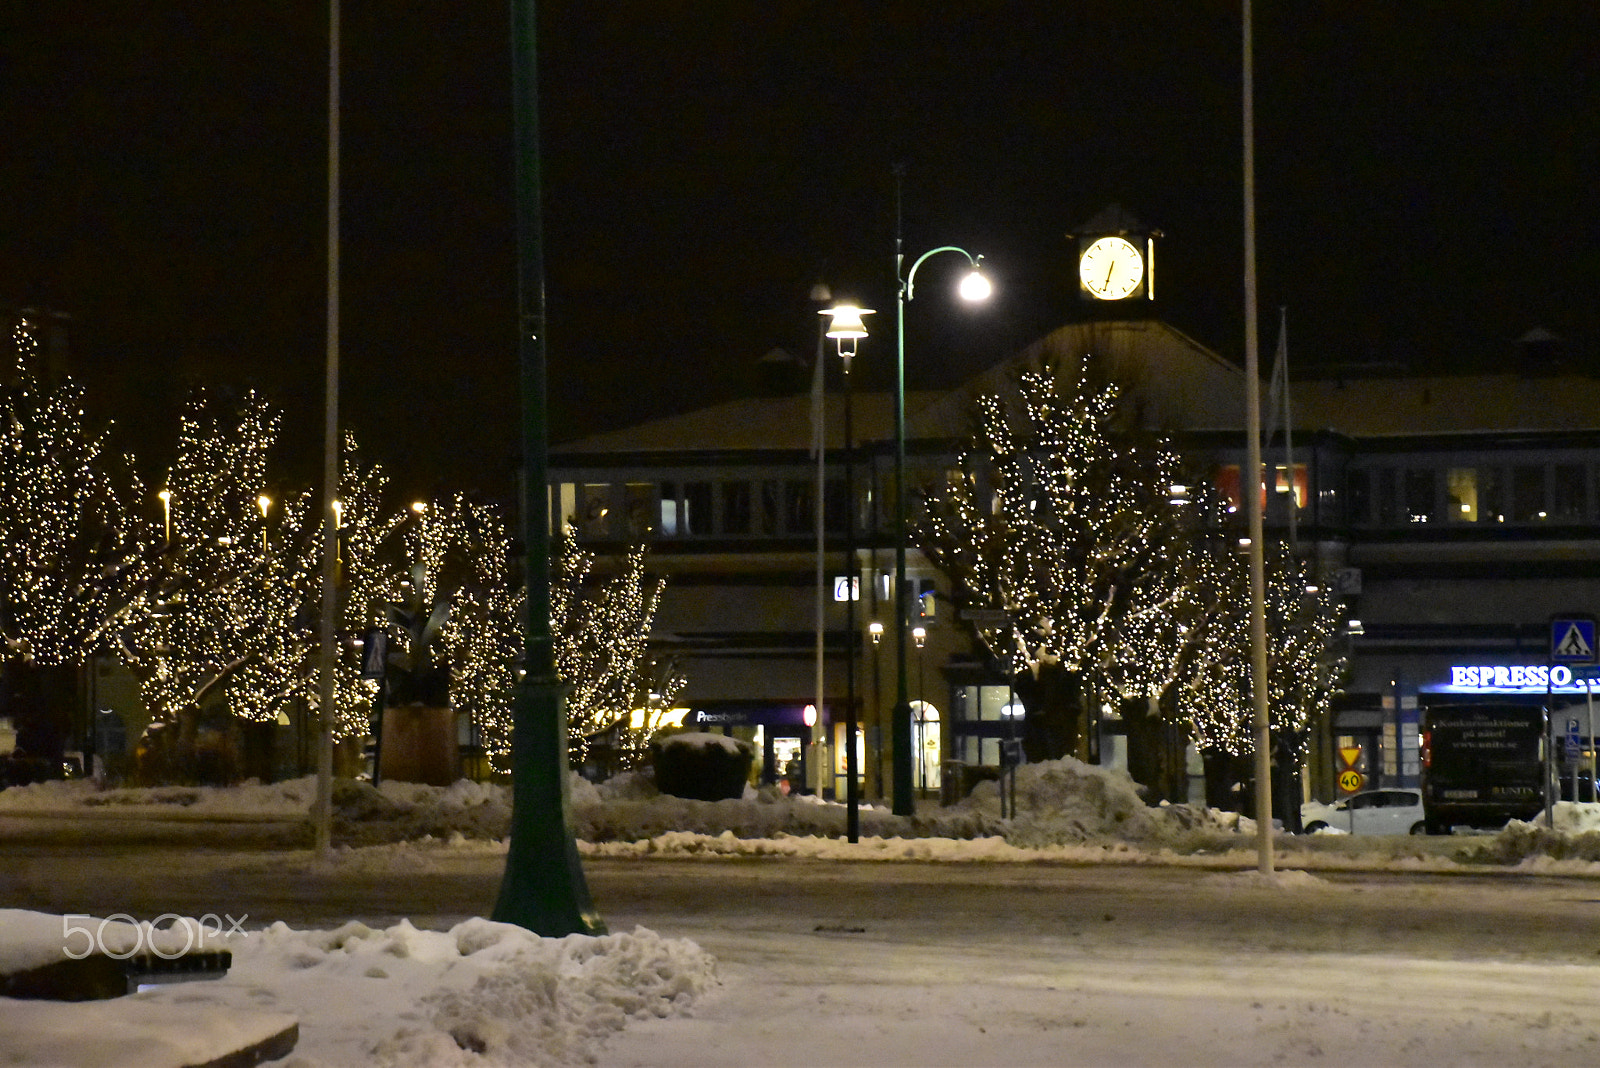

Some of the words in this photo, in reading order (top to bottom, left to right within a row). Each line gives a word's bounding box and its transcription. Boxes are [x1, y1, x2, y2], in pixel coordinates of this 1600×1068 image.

[1451, 666, 1571, 686] ESPRESSO
[1341, 775, 1360, 787] 40
[1501, 787, 1534, 795] UNITS
